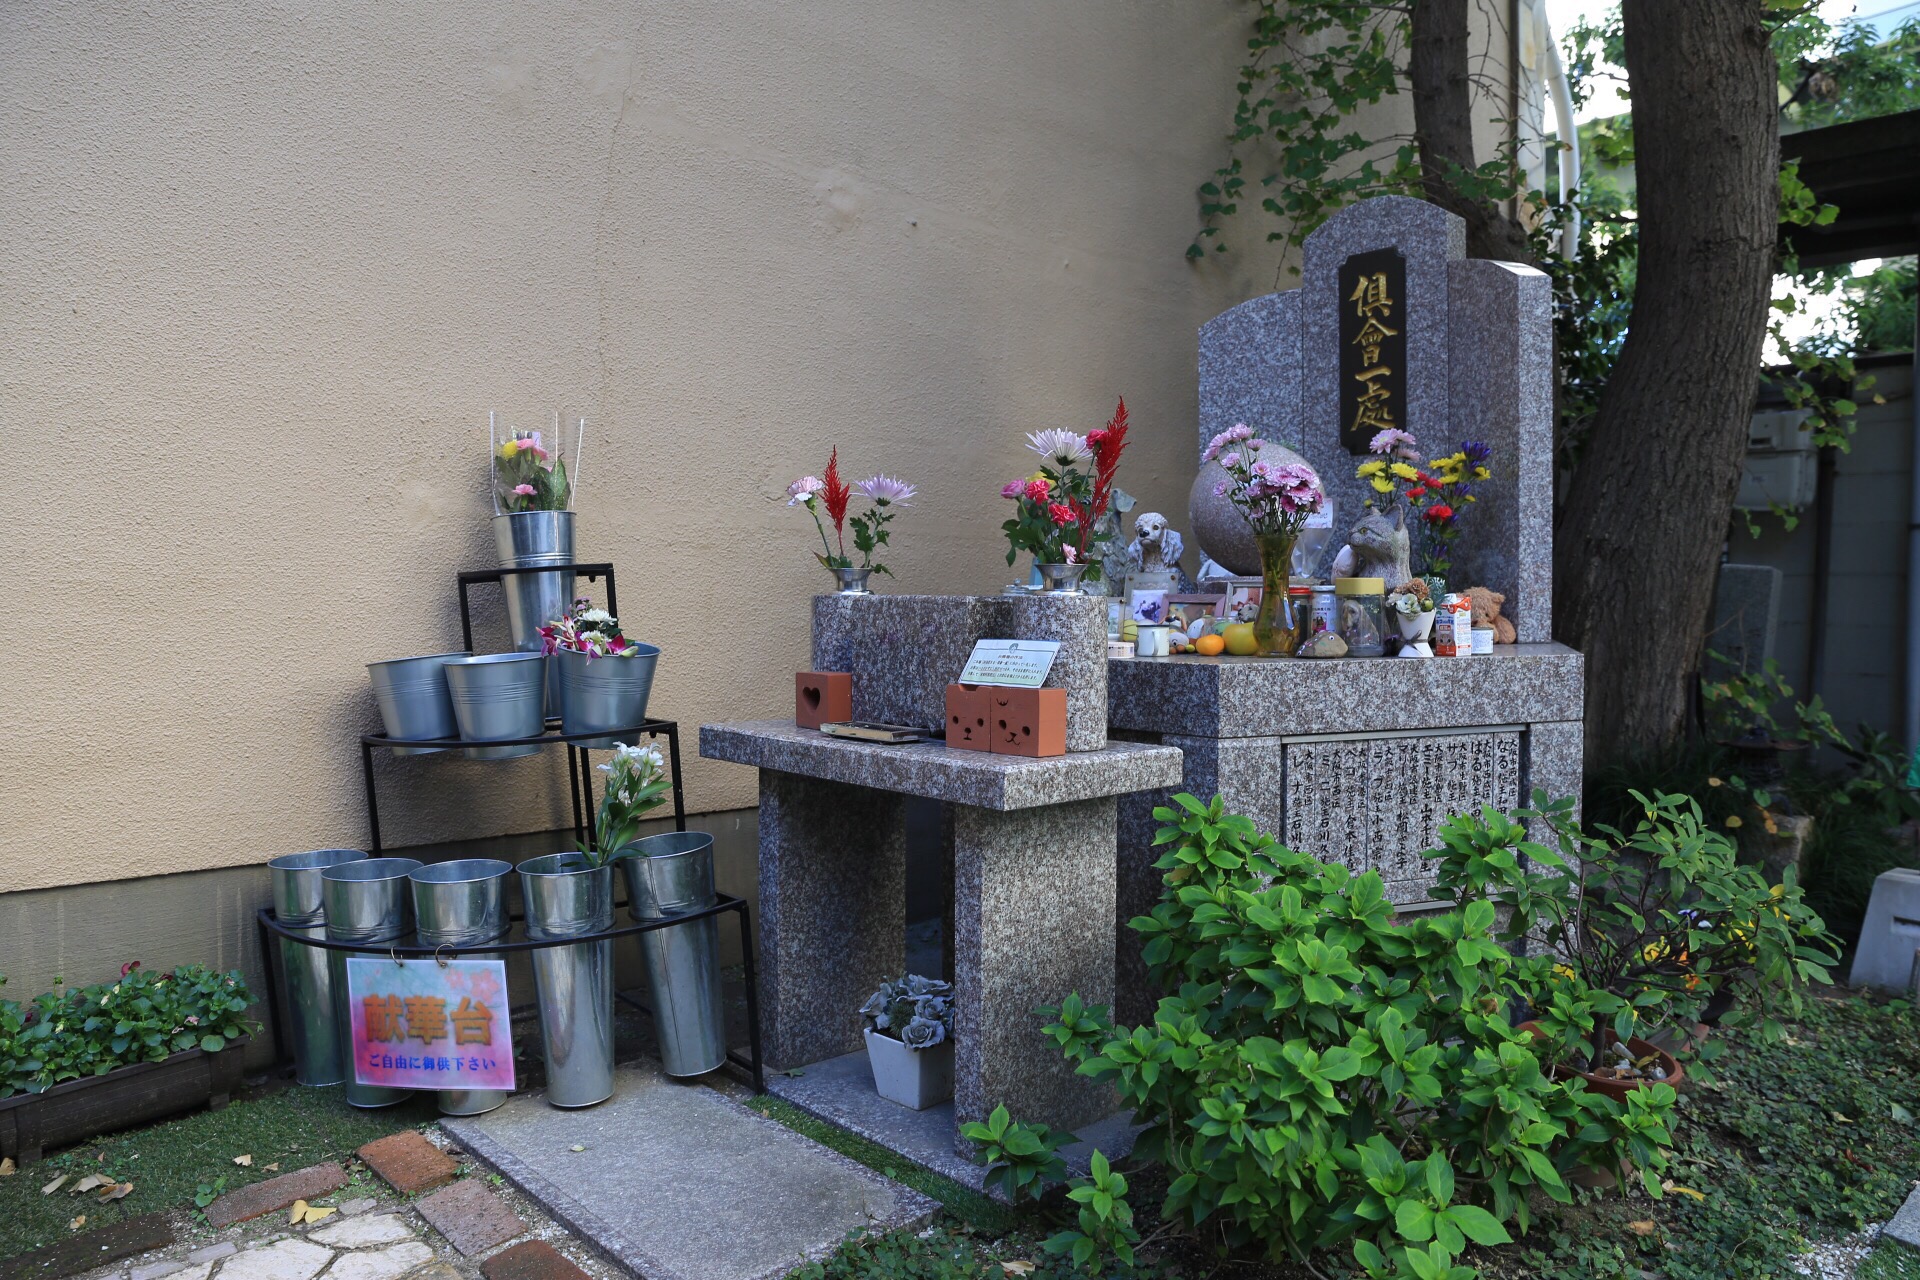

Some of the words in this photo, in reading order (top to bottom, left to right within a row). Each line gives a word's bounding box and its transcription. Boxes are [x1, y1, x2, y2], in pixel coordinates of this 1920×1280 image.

[363, 993, 493, 1046] 献華台
[369, 1053, 496, 1072] ご自由に御供下さい
